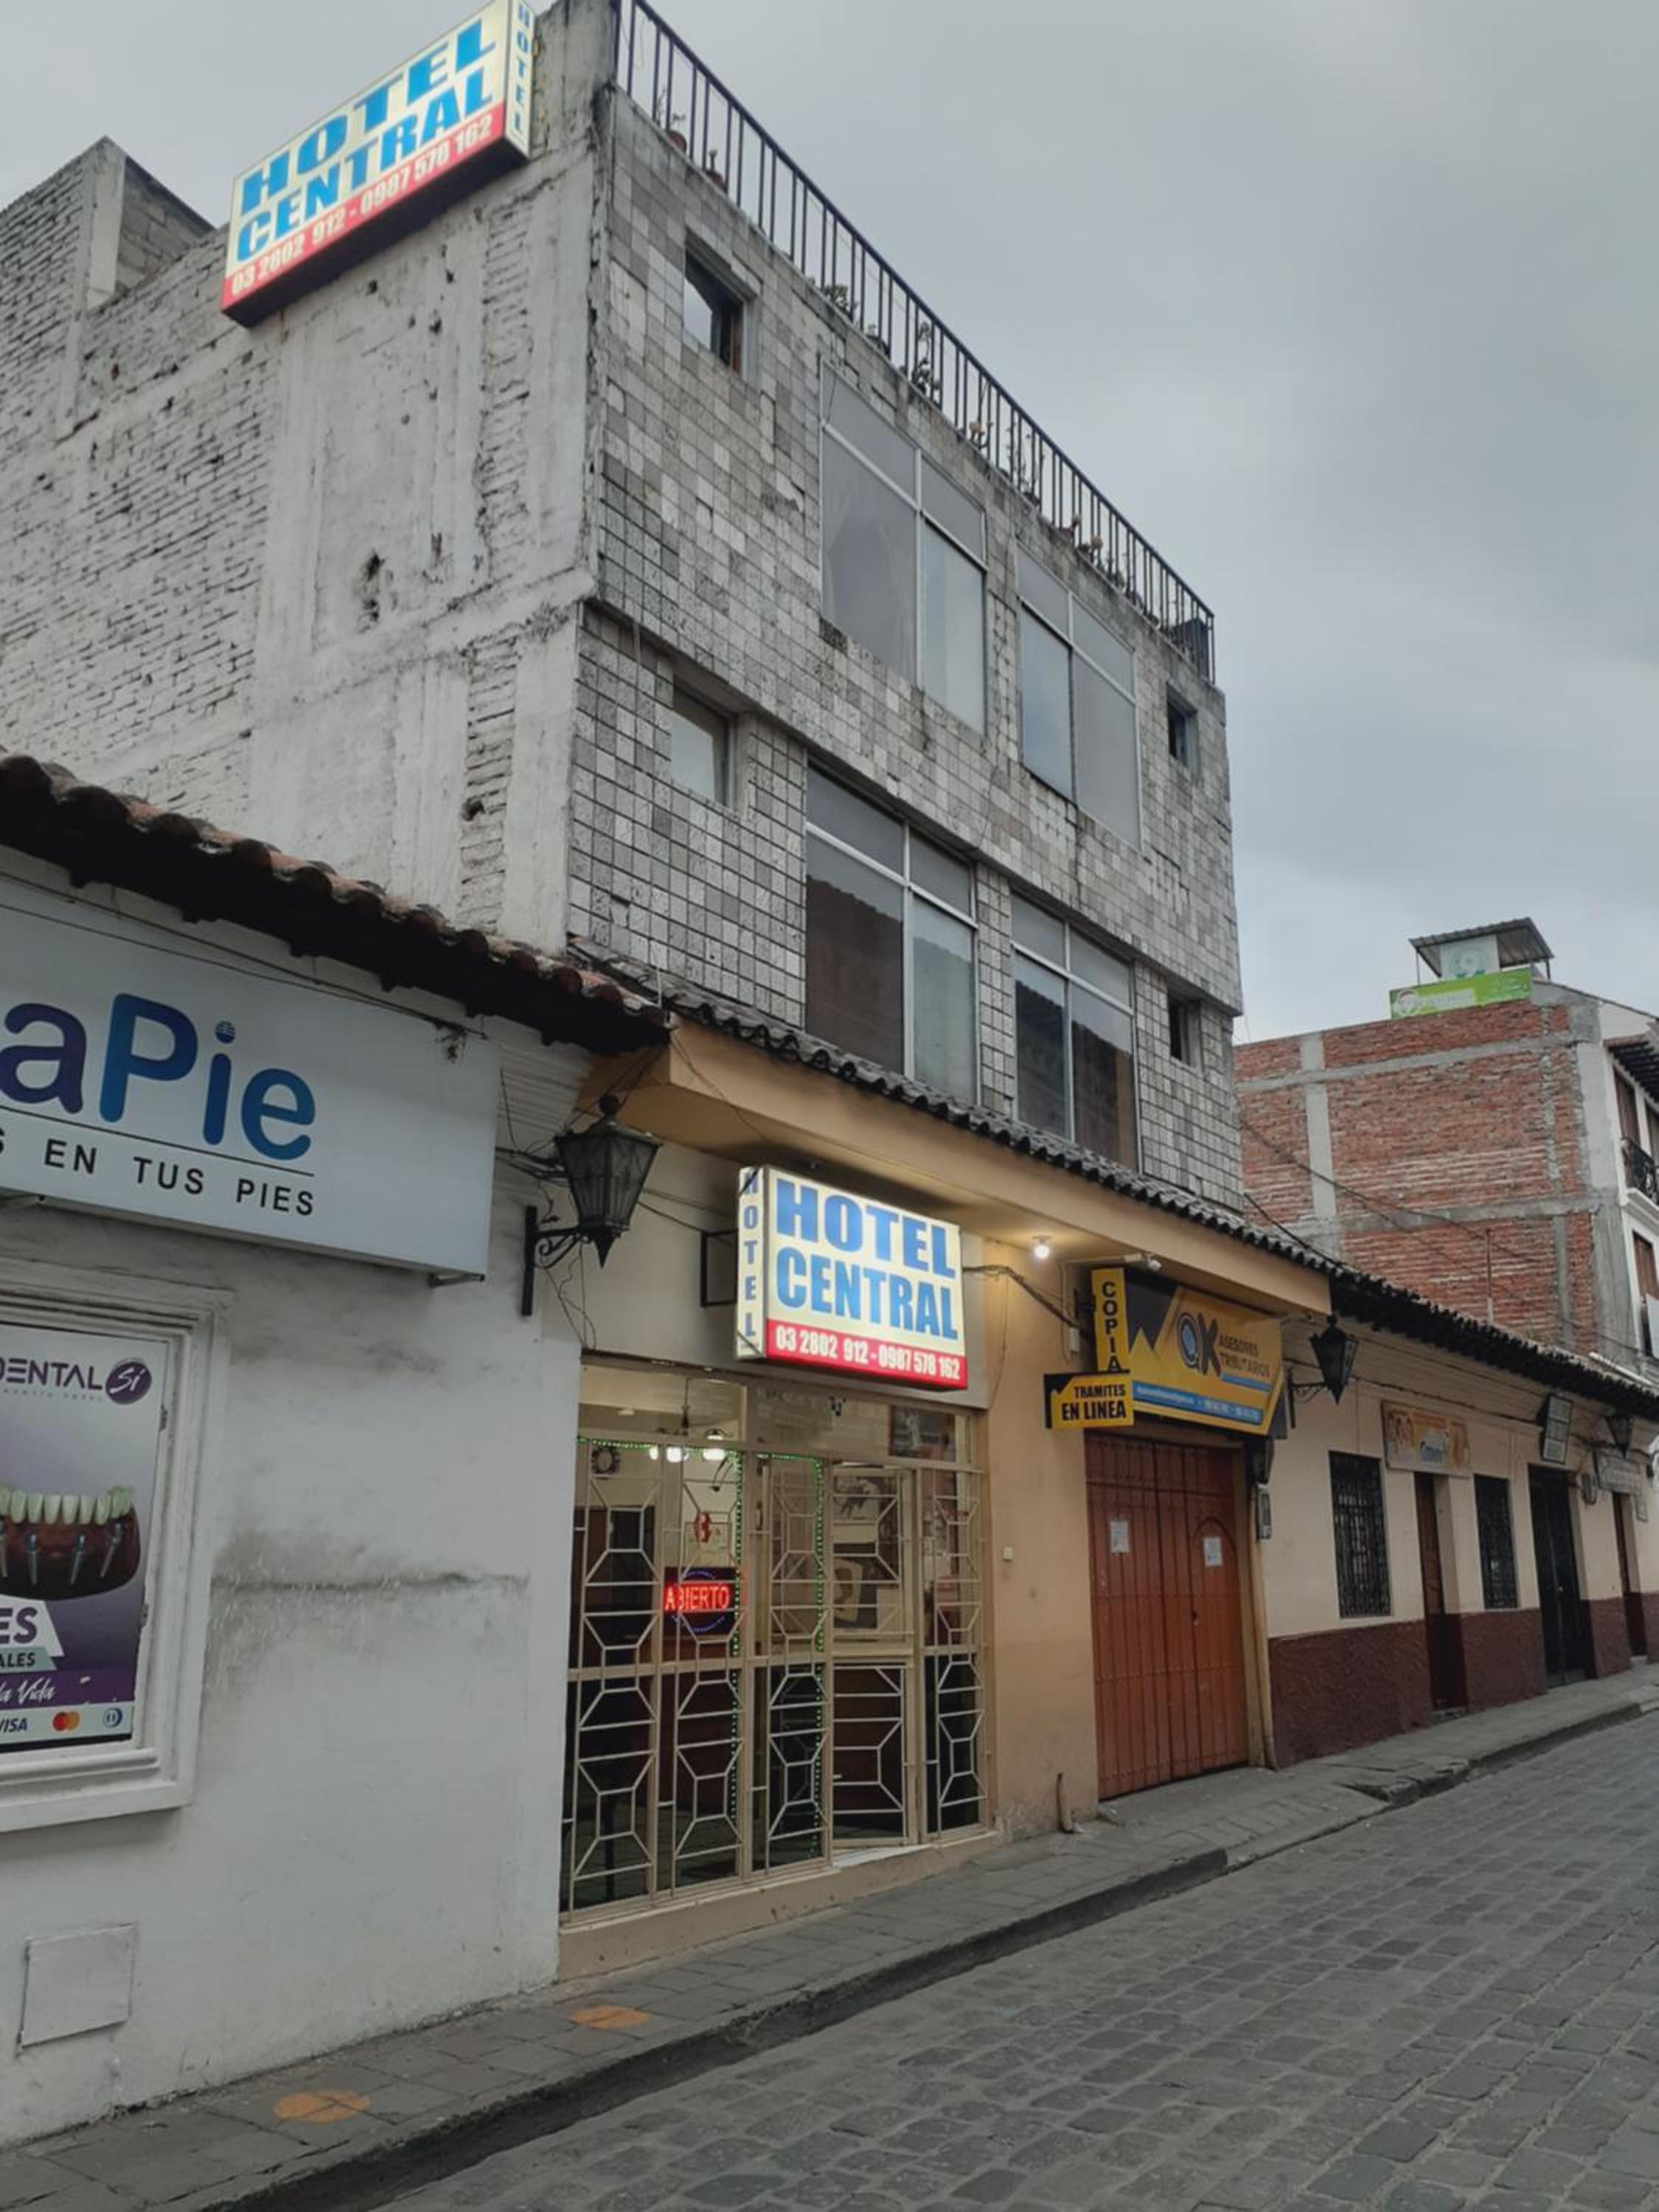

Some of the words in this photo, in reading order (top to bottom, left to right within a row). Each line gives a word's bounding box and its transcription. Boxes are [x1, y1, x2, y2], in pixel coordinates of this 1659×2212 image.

[515, 4, 529, 131] HOTEL
[241, 18, 495, 217] HOTEL
[232, 264, 255, 296] 03
[258, 234, 305, 281] 2802
[313, 206, 346, 245] 912
[456, 114, 492, 154] 162
[237, 67, 493, 262] CENTRAL
[44, 1138, 97, 1175] EN
[133, 1155, 204, 1194] TUS
[236, 1178, 313, 1216] PIES
[742, 1169, 759, 1338] HOTEL
[776, 1178, 956, 1279] HOTEL
[776, 1246, 958, 1340] CENTRAL
[1102, 1281, 1121, 1372] COPIA
[0, 1356, 102, 1391] ENTAL
[776, 1325, 796, 1352] 03
[799, 1329, 838, 1360] 2802
[843, 1338, 869, 1365] 912
[878, 1344, 912, 1371] 0987
[939, 1356, 961, 1380] 162
[1074, 1383, 1126, 1399] TRAMITES
[1062, 1402, 1079, 1420] EN
[1083, 1400, 1127, 1419] LINEA
[664, 1585, 730, 1612] ABIERTO
